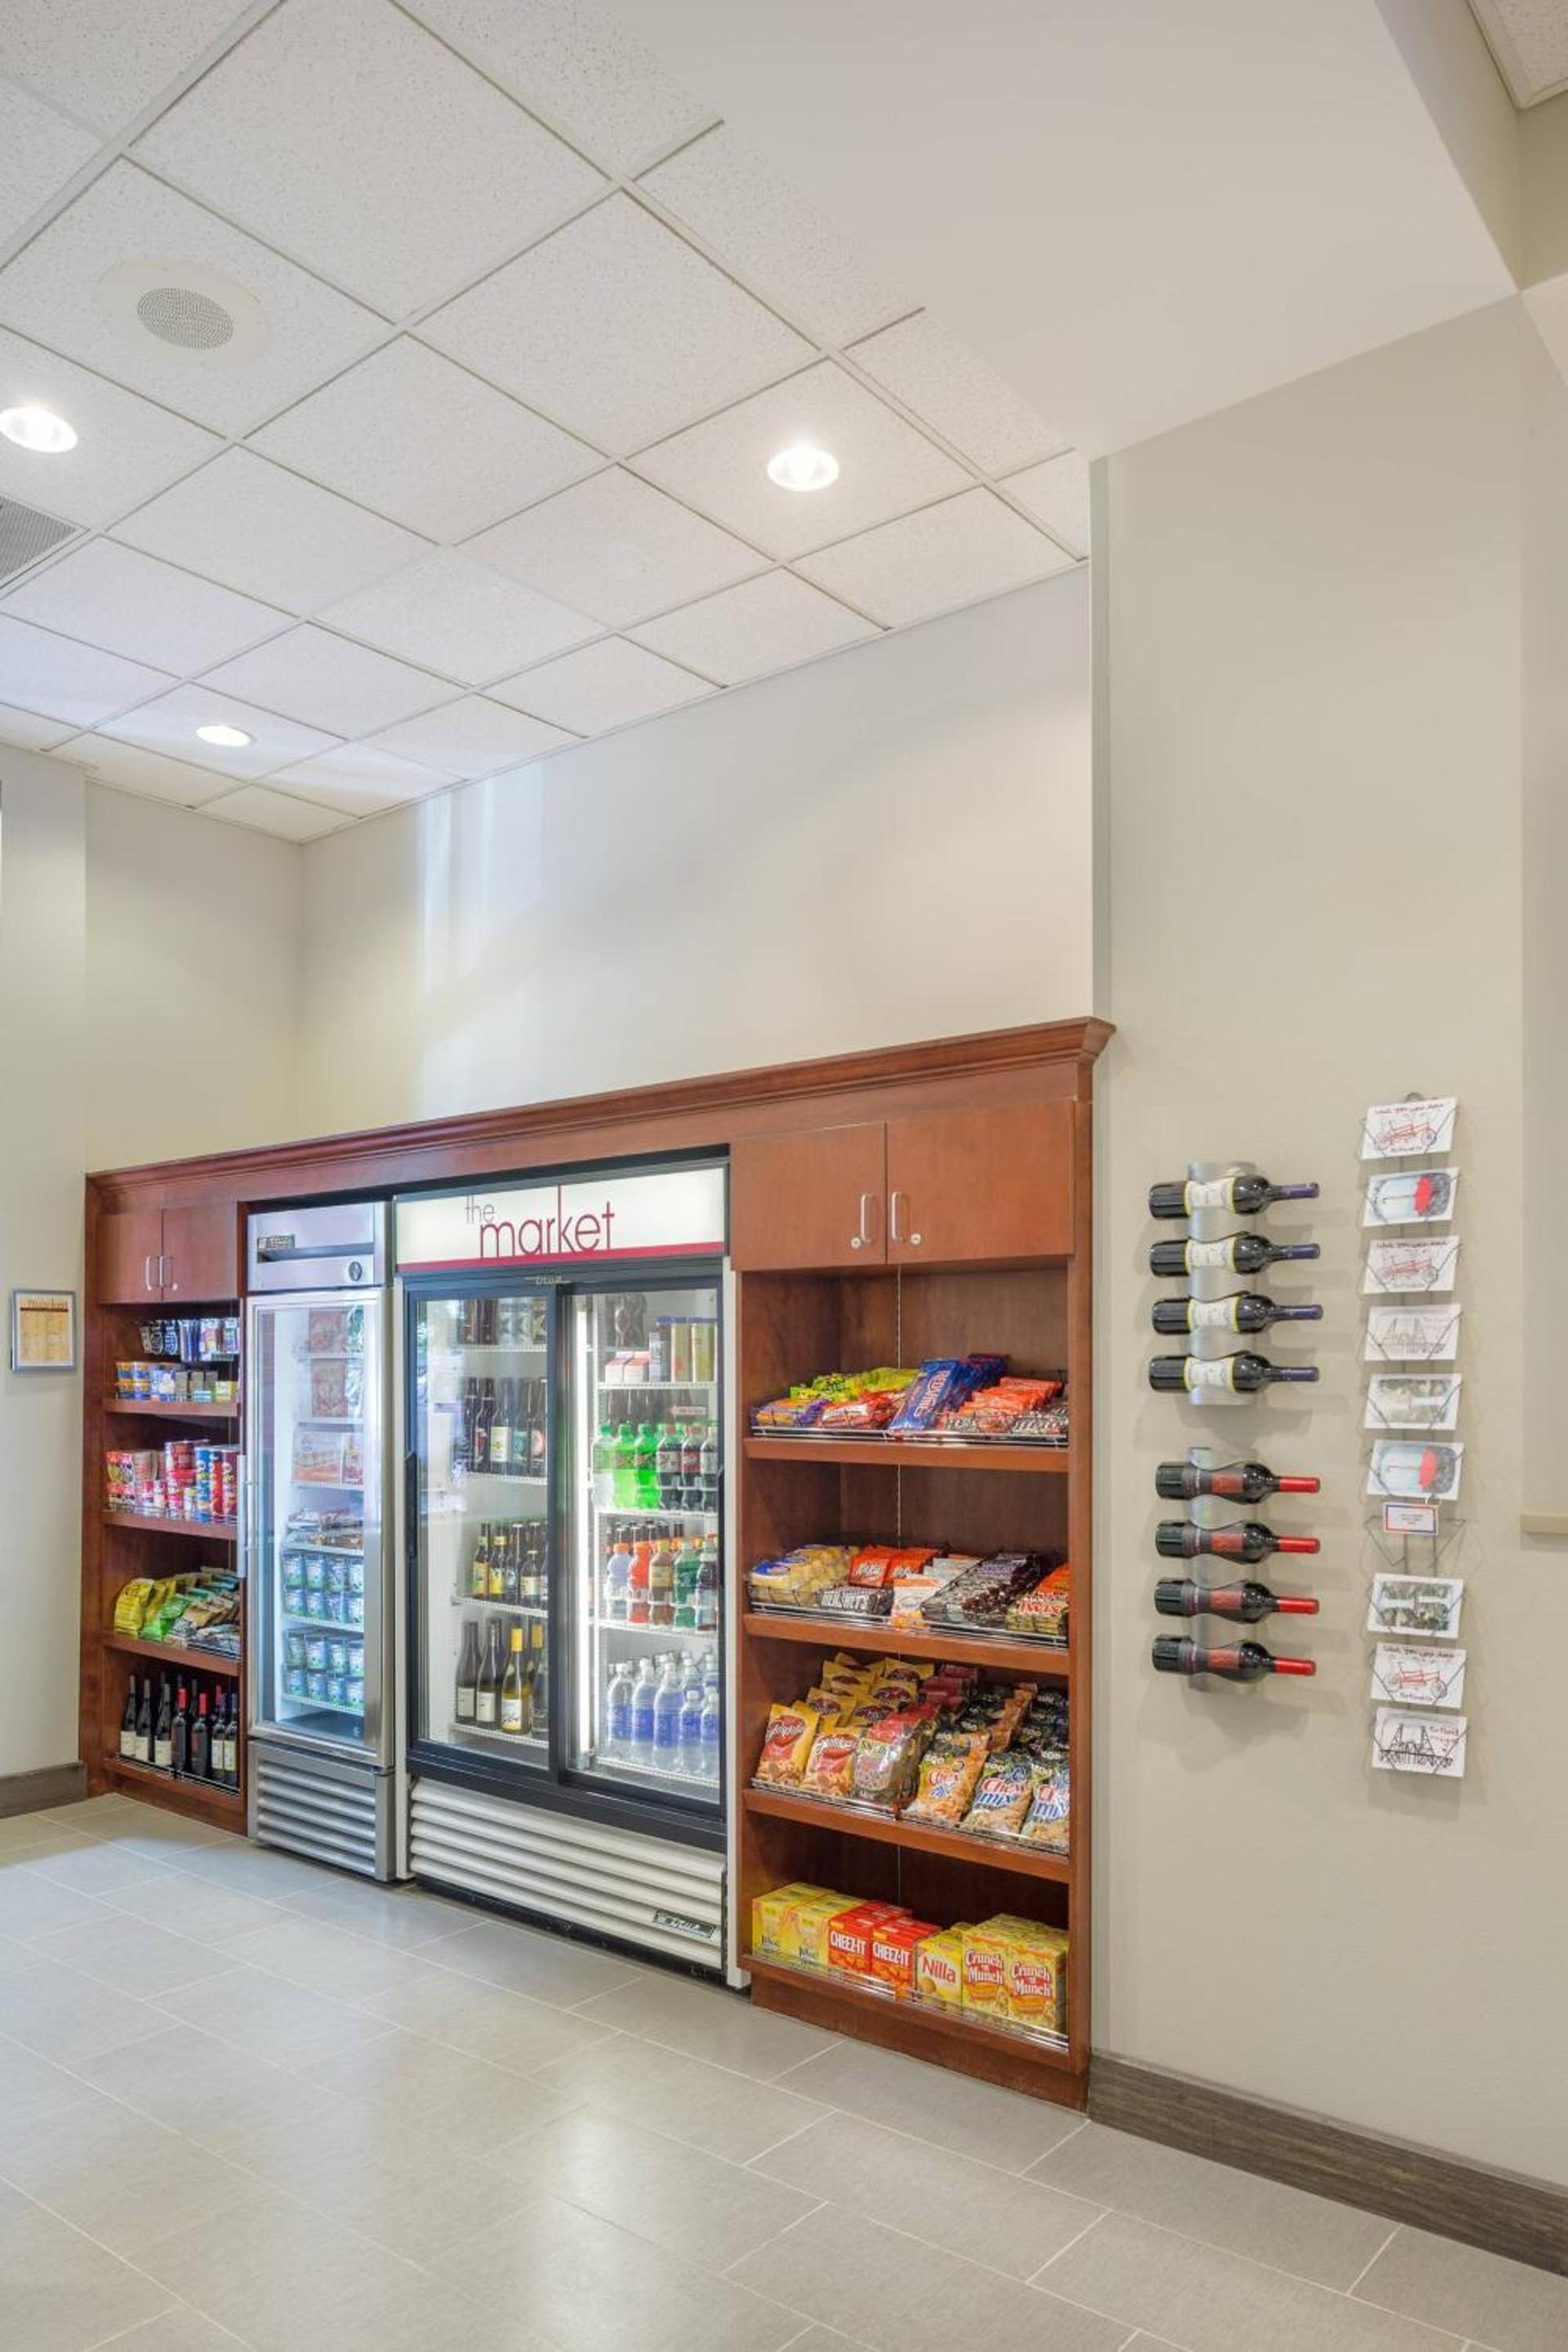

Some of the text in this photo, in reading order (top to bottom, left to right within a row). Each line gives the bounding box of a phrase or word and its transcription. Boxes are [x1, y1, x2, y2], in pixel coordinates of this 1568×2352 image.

[466, 1194, 495, 1223] the
[480, 1183, 615, 1258] market
[981, 1777, 1025, 1793] Chex
[979, 1793, 1015, 1807] mix
[830, 1931, 866, 1956] CHEEZ-IT
[872, 1941, 911, 1967] CHEEZ-IT
[965, 1949, 1003, 1968] Crunch
[923, 1956, 956, 1984] Nilla
[967, 1966, 1004, 1985] Munch
[1012, 1961, 1051, 1980] Crunch
[1014, 1980, 1052, 1998] Munch
